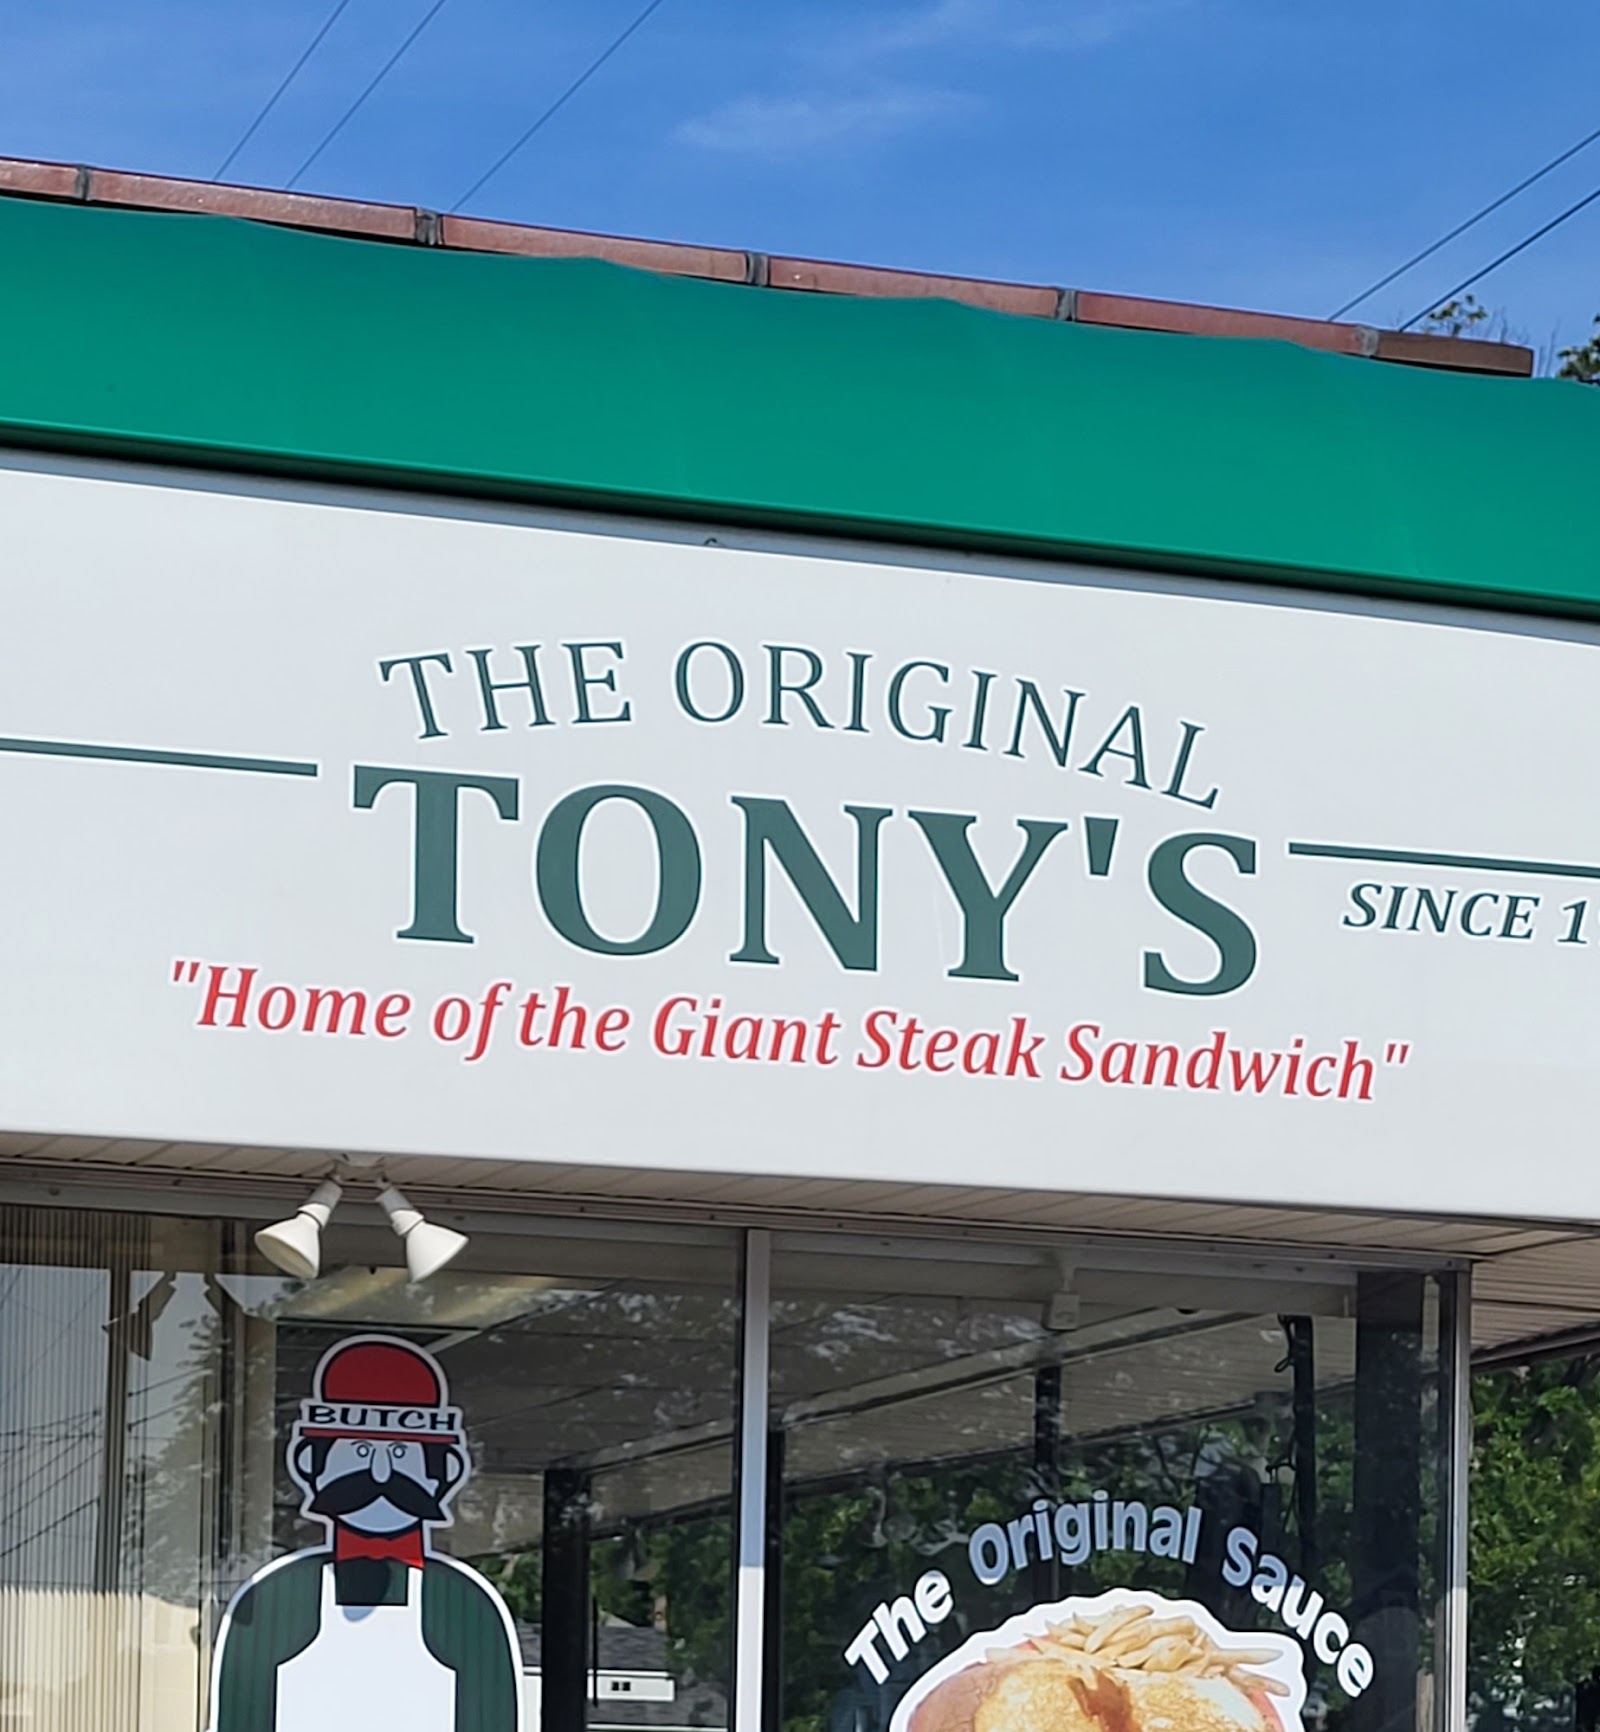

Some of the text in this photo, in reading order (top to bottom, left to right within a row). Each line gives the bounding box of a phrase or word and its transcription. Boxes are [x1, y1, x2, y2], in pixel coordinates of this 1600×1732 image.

[378, 640, 1220, 811] THE ORIGINAL
[352, 763, 1258, 998] TONY'S
[1341, 882, 1542, 941] SINCE
[172, 960, 1409, 1101] "Home of the Giant Steak Sandwich"
[307, 1404, 457, 1432] BUTCH
[844, 1489, 1374, 1698] The Original Sauce
